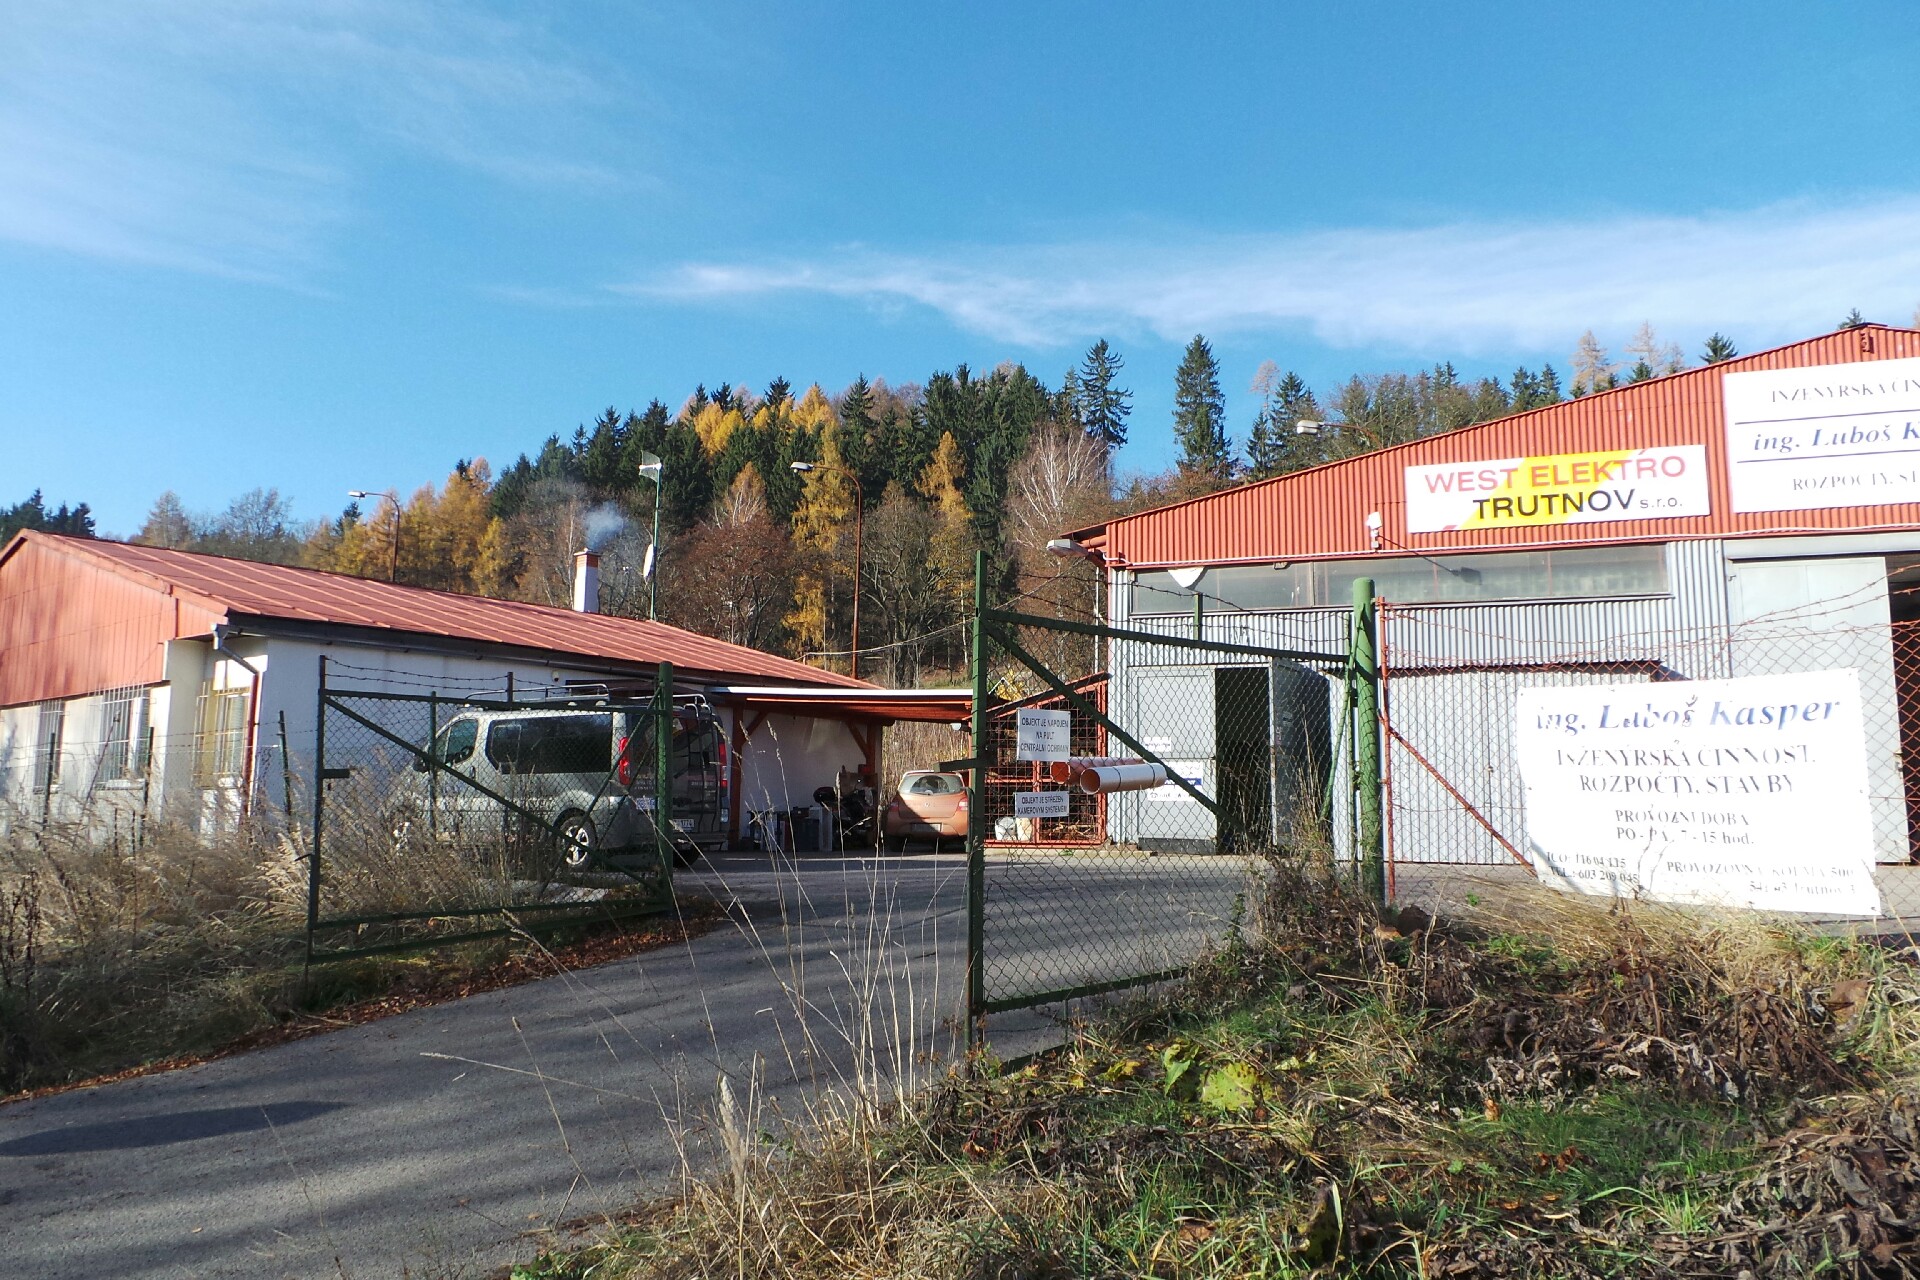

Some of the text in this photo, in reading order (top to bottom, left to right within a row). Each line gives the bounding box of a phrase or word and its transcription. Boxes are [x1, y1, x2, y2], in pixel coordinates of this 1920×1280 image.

[1754, 433, 1800, 453] ing.
[1811, 424, 1891, 446] Luboš
[1425, 455, 1687, 493] WEST ELEKTRO
[1472, 488, 1684, 520] TRUTNOV s.r.o.
[1021, 717, 1040, 727] OBJEKT
[1536, 706, 1586, 736] ing.
[1710, 701, 1841, 730] Kasper
[1705, 774, 1793, 794] STAVBY
[1616, 826, 1636, 840] PO
[1702, 831, 1717, 844] 15
[1578, 869, 1597, 880] 603
